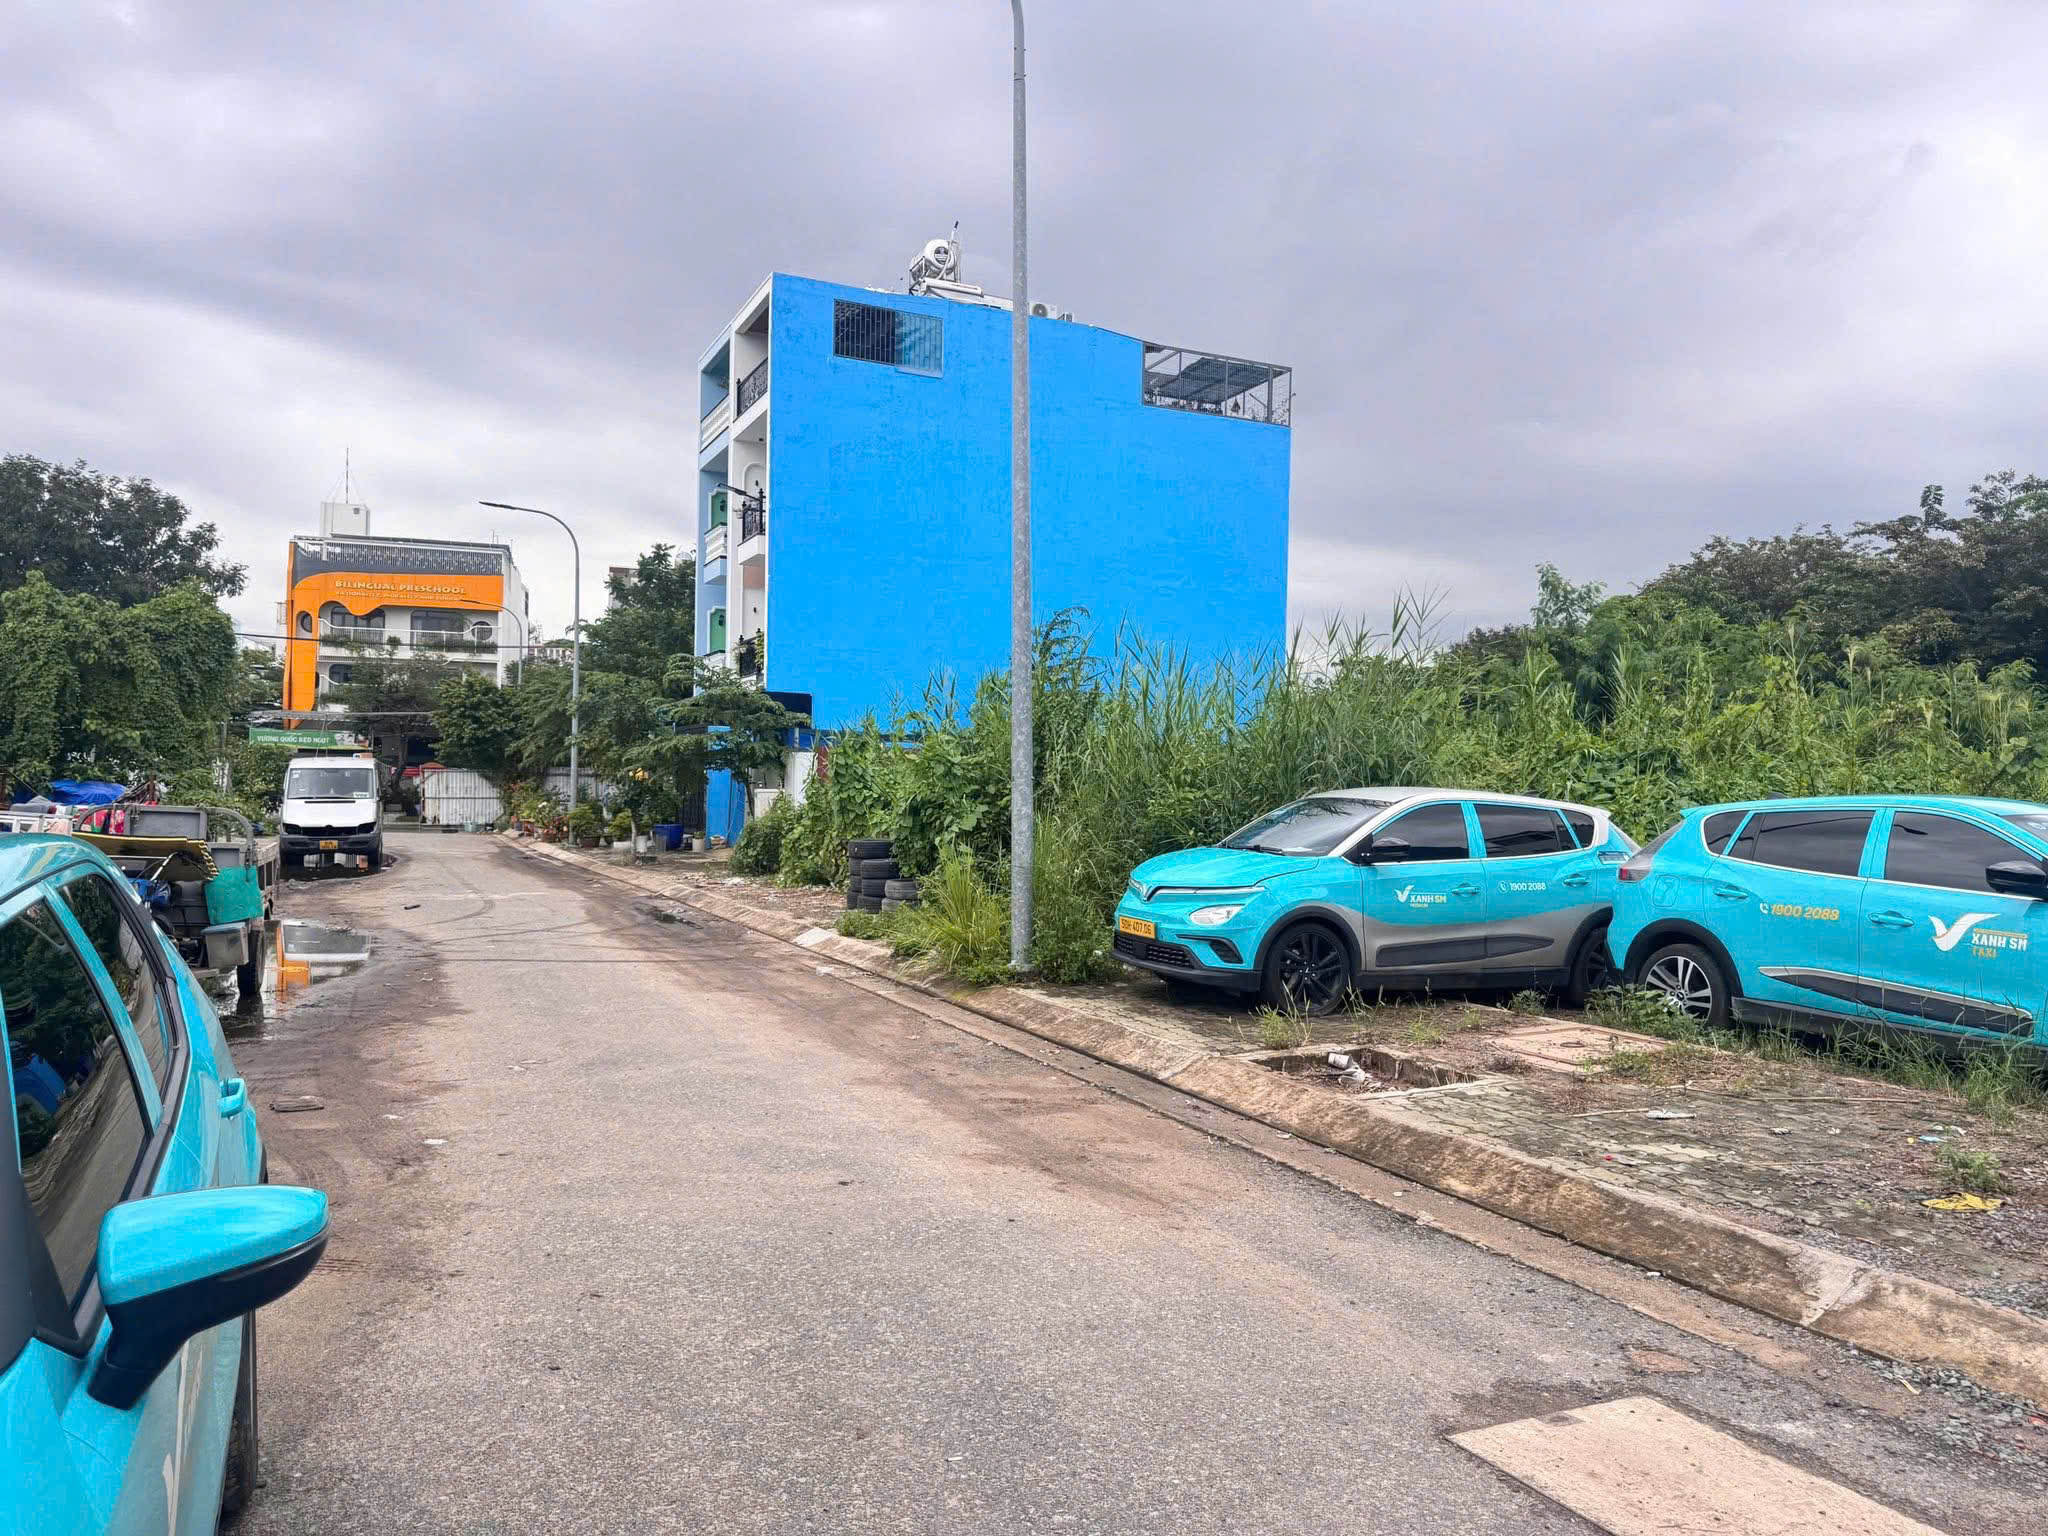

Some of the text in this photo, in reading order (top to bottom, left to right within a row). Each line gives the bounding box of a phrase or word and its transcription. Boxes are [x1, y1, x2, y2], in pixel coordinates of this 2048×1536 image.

[336, 580, 466, 595] BILINGUAL PRESCHOOL
[1510, 882, 1527, 891] 1900
[1410, 895, 1447, 903] XANH SM
[1771, 904, 1840, 920] 1900 2088
[1971, 933, 2028, 951] XANH SM
